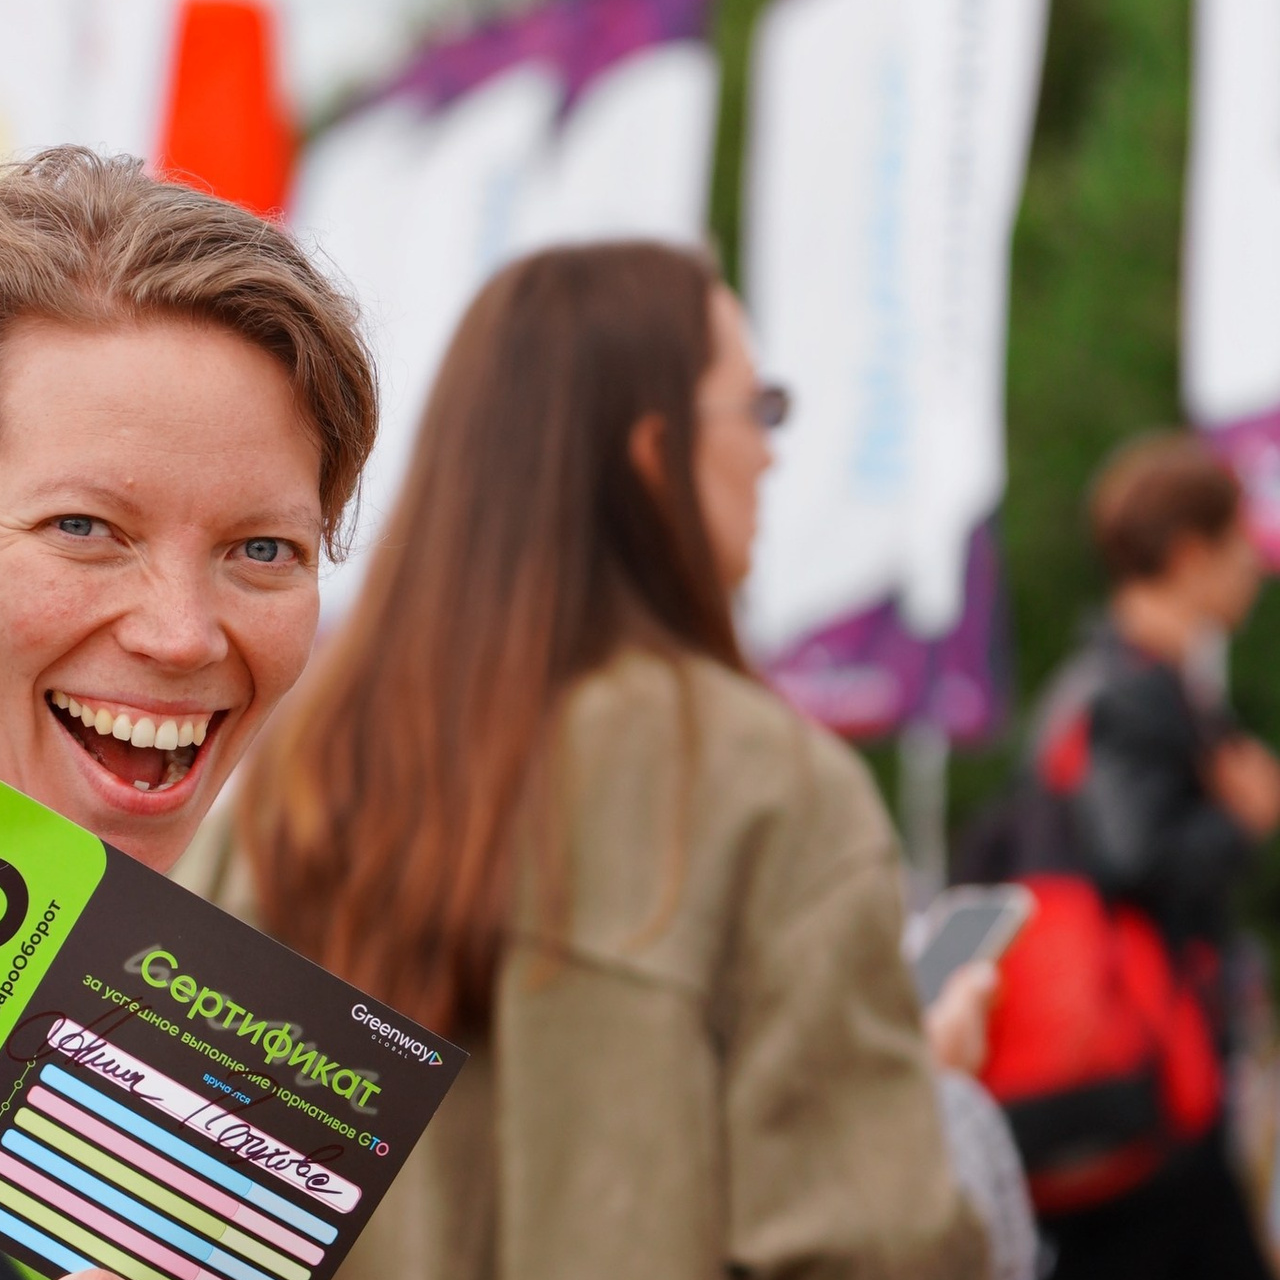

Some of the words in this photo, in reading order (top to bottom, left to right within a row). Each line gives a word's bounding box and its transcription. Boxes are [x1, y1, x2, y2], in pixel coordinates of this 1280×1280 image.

[83, 974, 102, 992] за
[358, 1132, 390, 1157] GTO
[141, 950, 382, 1107] Сертификат
[351, 1003, 434, 1062] Greenway
[371, 1034, 409, 1059] GLOBAL
